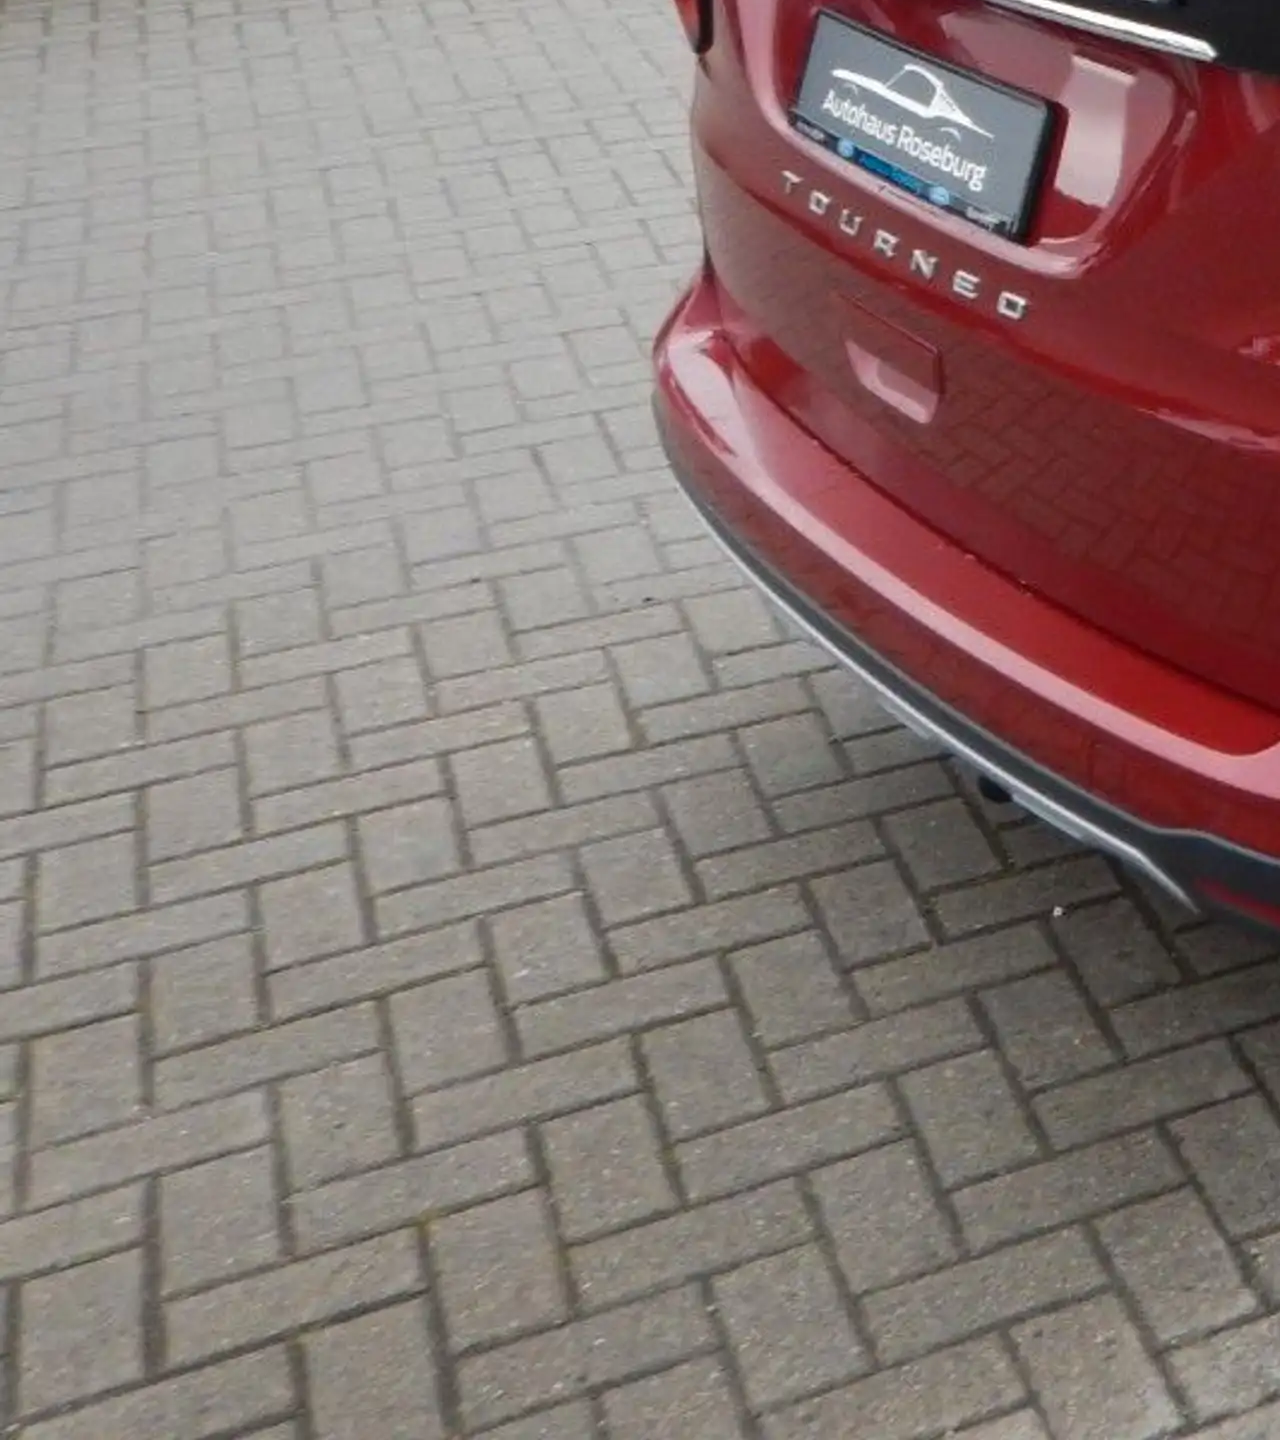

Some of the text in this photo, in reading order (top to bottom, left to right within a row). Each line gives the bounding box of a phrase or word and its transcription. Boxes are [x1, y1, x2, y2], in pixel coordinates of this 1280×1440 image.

[822, 89, 898, 145] Autohaus
[897, 125, 987, 192] Roseburg
[781, 170, 1029, 320] TOURNEO
